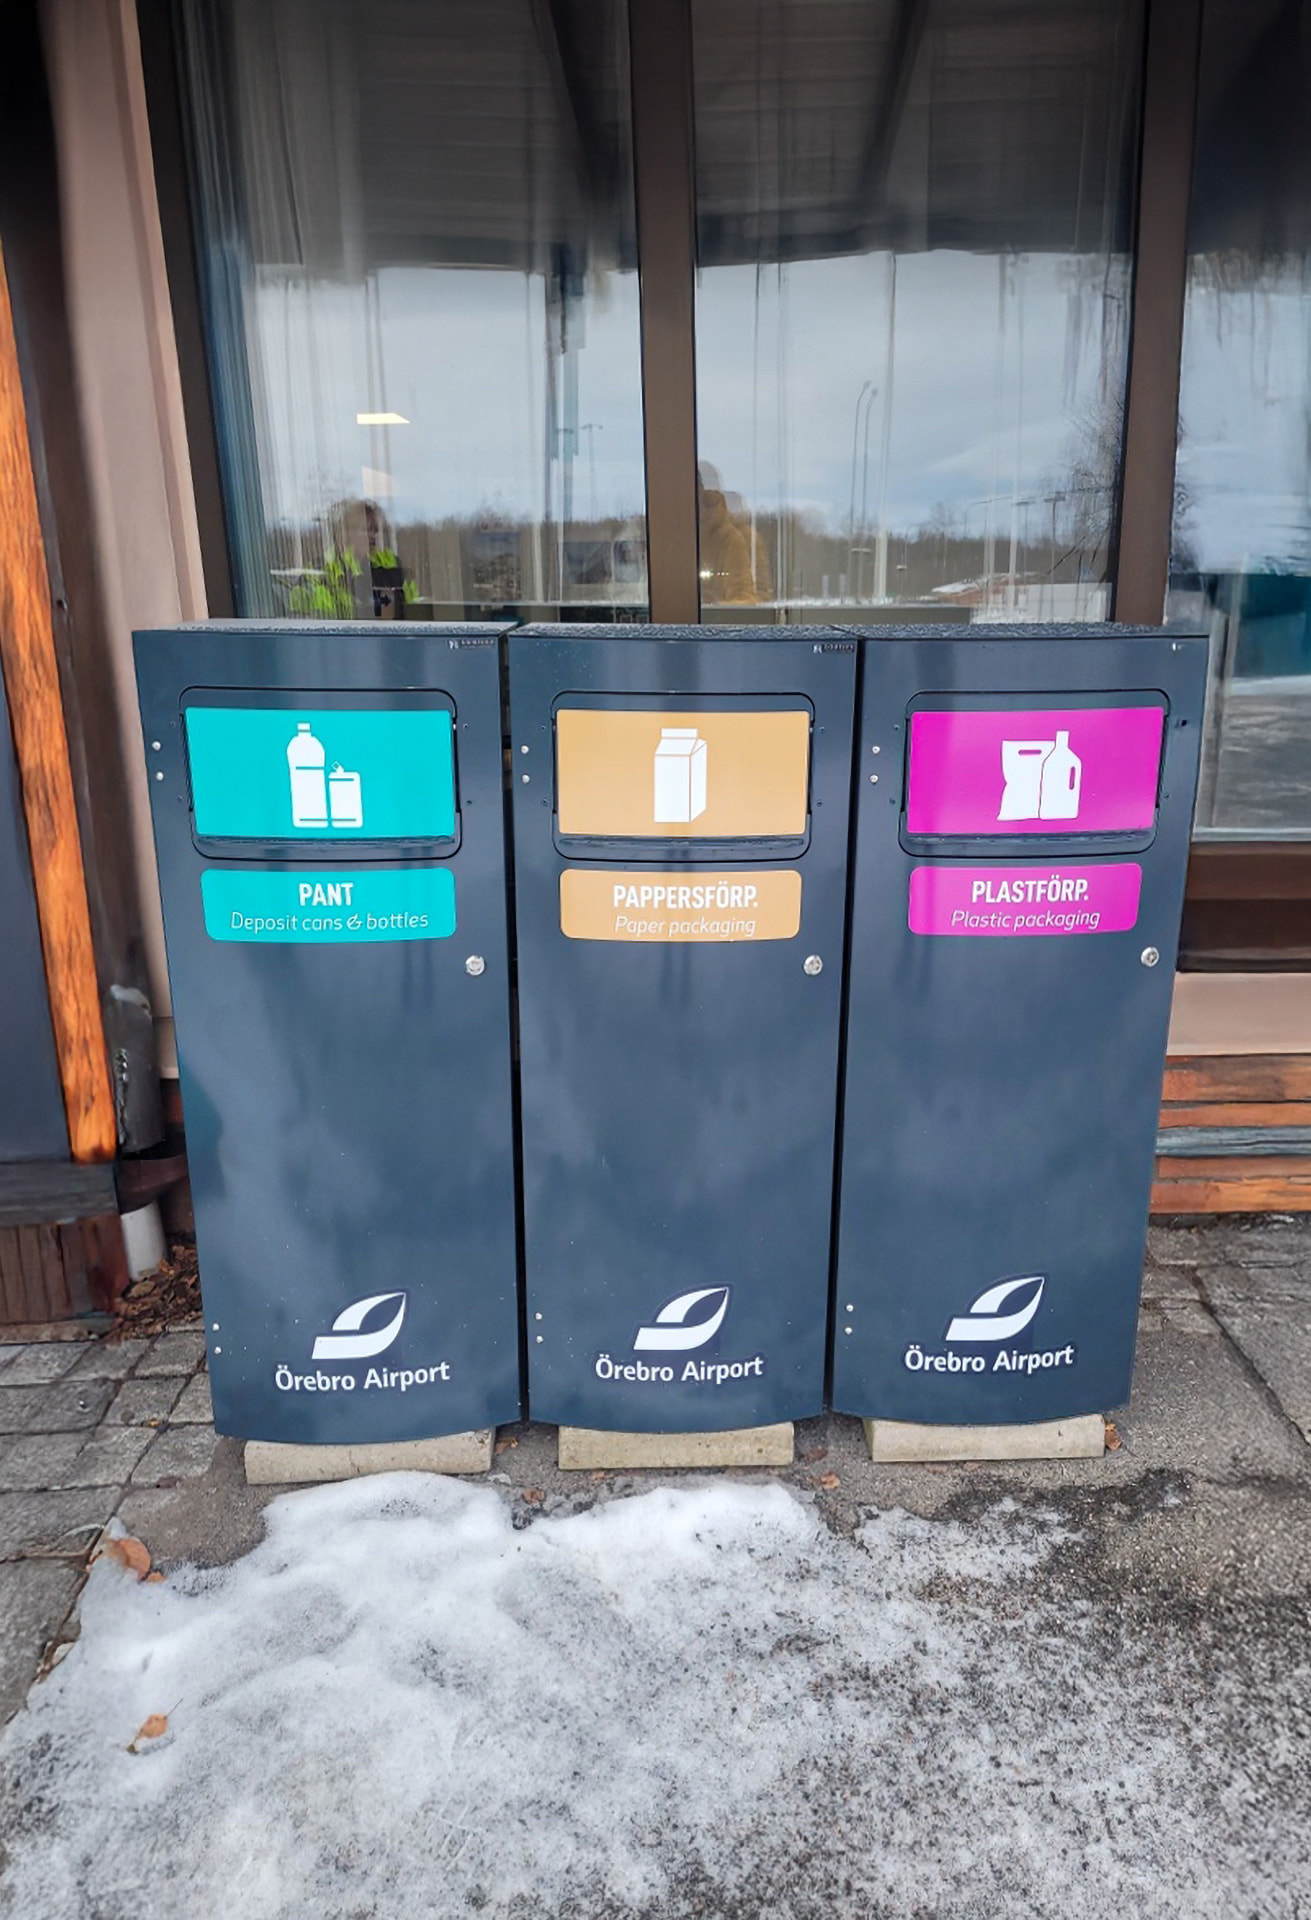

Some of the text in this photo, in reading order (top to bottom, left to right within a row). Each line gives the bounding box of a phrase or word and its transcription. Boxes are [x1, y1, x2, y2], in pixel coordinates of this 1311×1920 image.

[299, 882, 354, 906] PANT
[613, 880, 758, 909] PAPPERSFÖRP.
[971, 875, 1089, 903] PLASTFÖRP.
[230, 912, 429, 934] Deposit cans & bottles
[614, 916, 756, 937] Paper packaging
[951, 910, 1100, 932] Plastic packaging
[595, 1354, 764, 1384] Örebro Airport
[905, 1345, 1074, 1375] Örebro Airport
[275, 1361, 450, 1392] Örebro Airport
